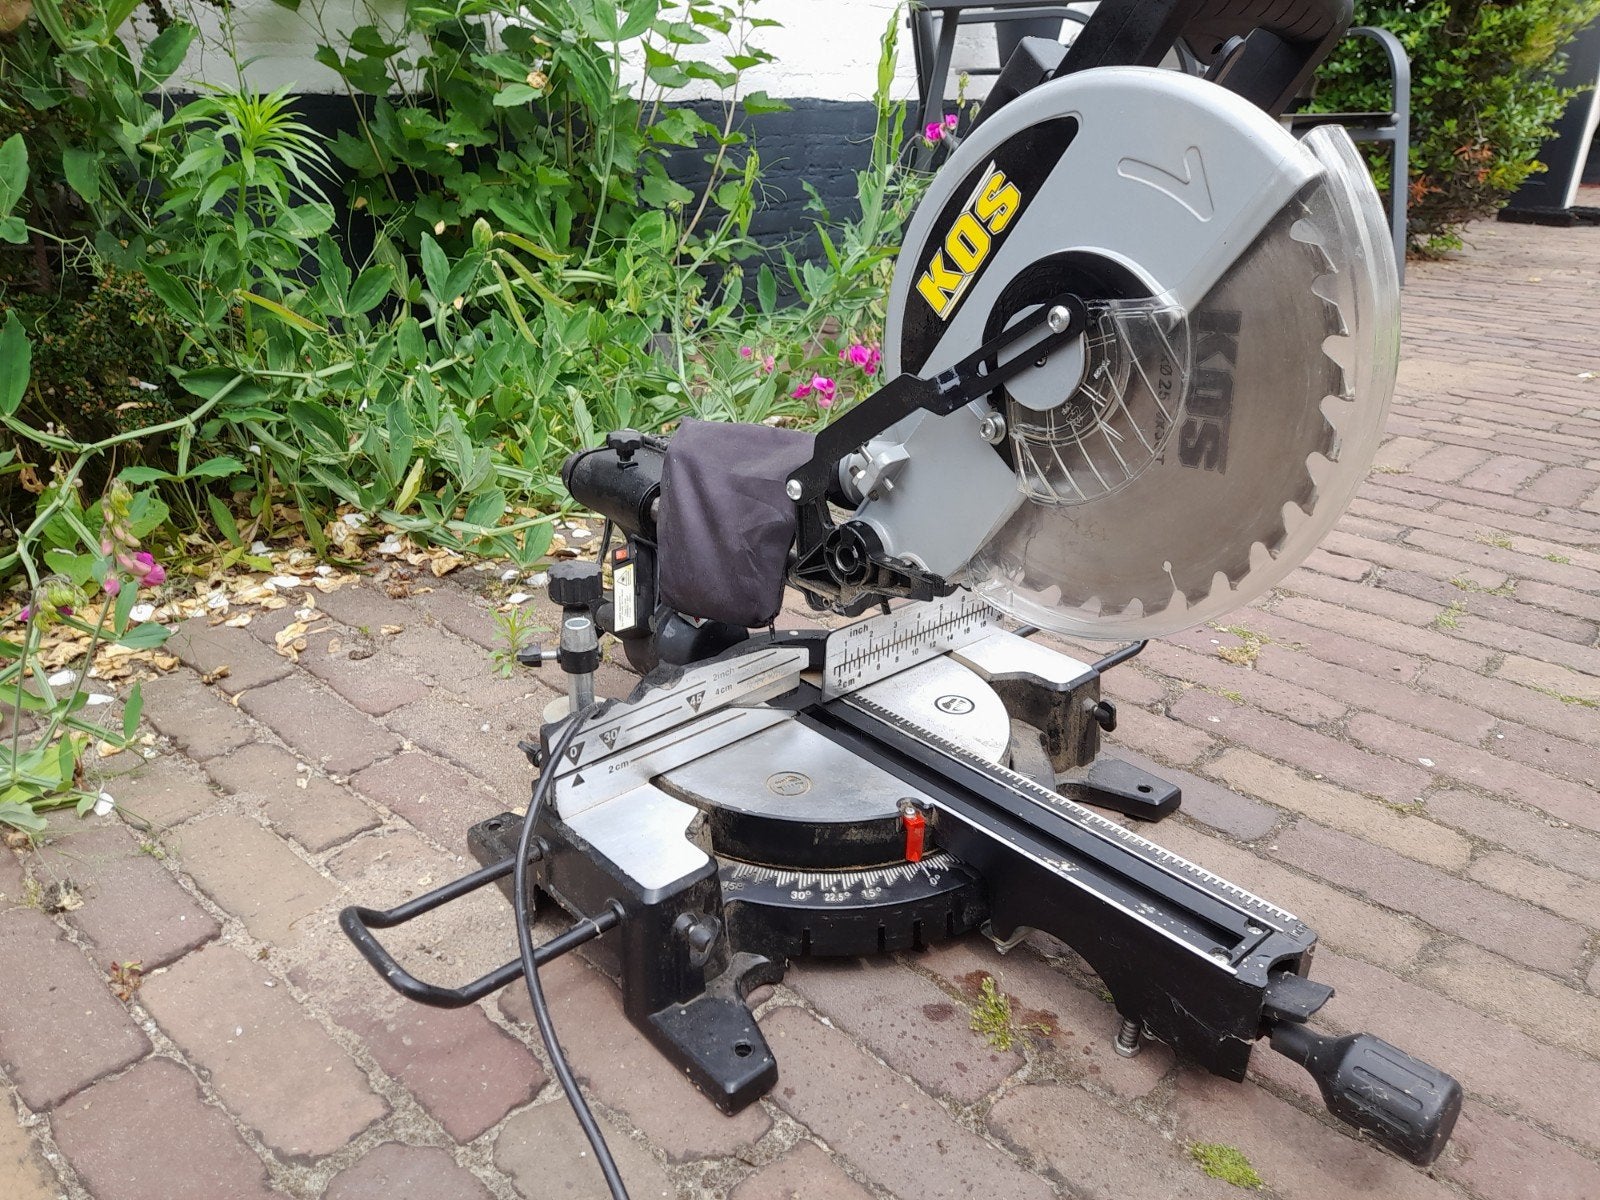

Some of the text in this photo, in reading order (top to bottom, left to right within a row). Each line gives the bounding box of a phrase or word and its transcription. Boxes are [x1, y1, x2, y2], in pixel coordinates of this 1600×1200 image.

[916, 166, 1022, 320] KOS
[1178, 310, 1242, 476] KOS
[869, 630, 874, 638] 2
[893, 621, 898, 629] 3
[939, 603, 944, 611] 5
[849, 624, 869, 638] inch
[911, 648, 919, 656] 10
[929, 641, 937, 649] 12
[690, 692, 702, 706] 45
[603, 729, 618, 743] 30
[569, 746, 578, 758] 0
